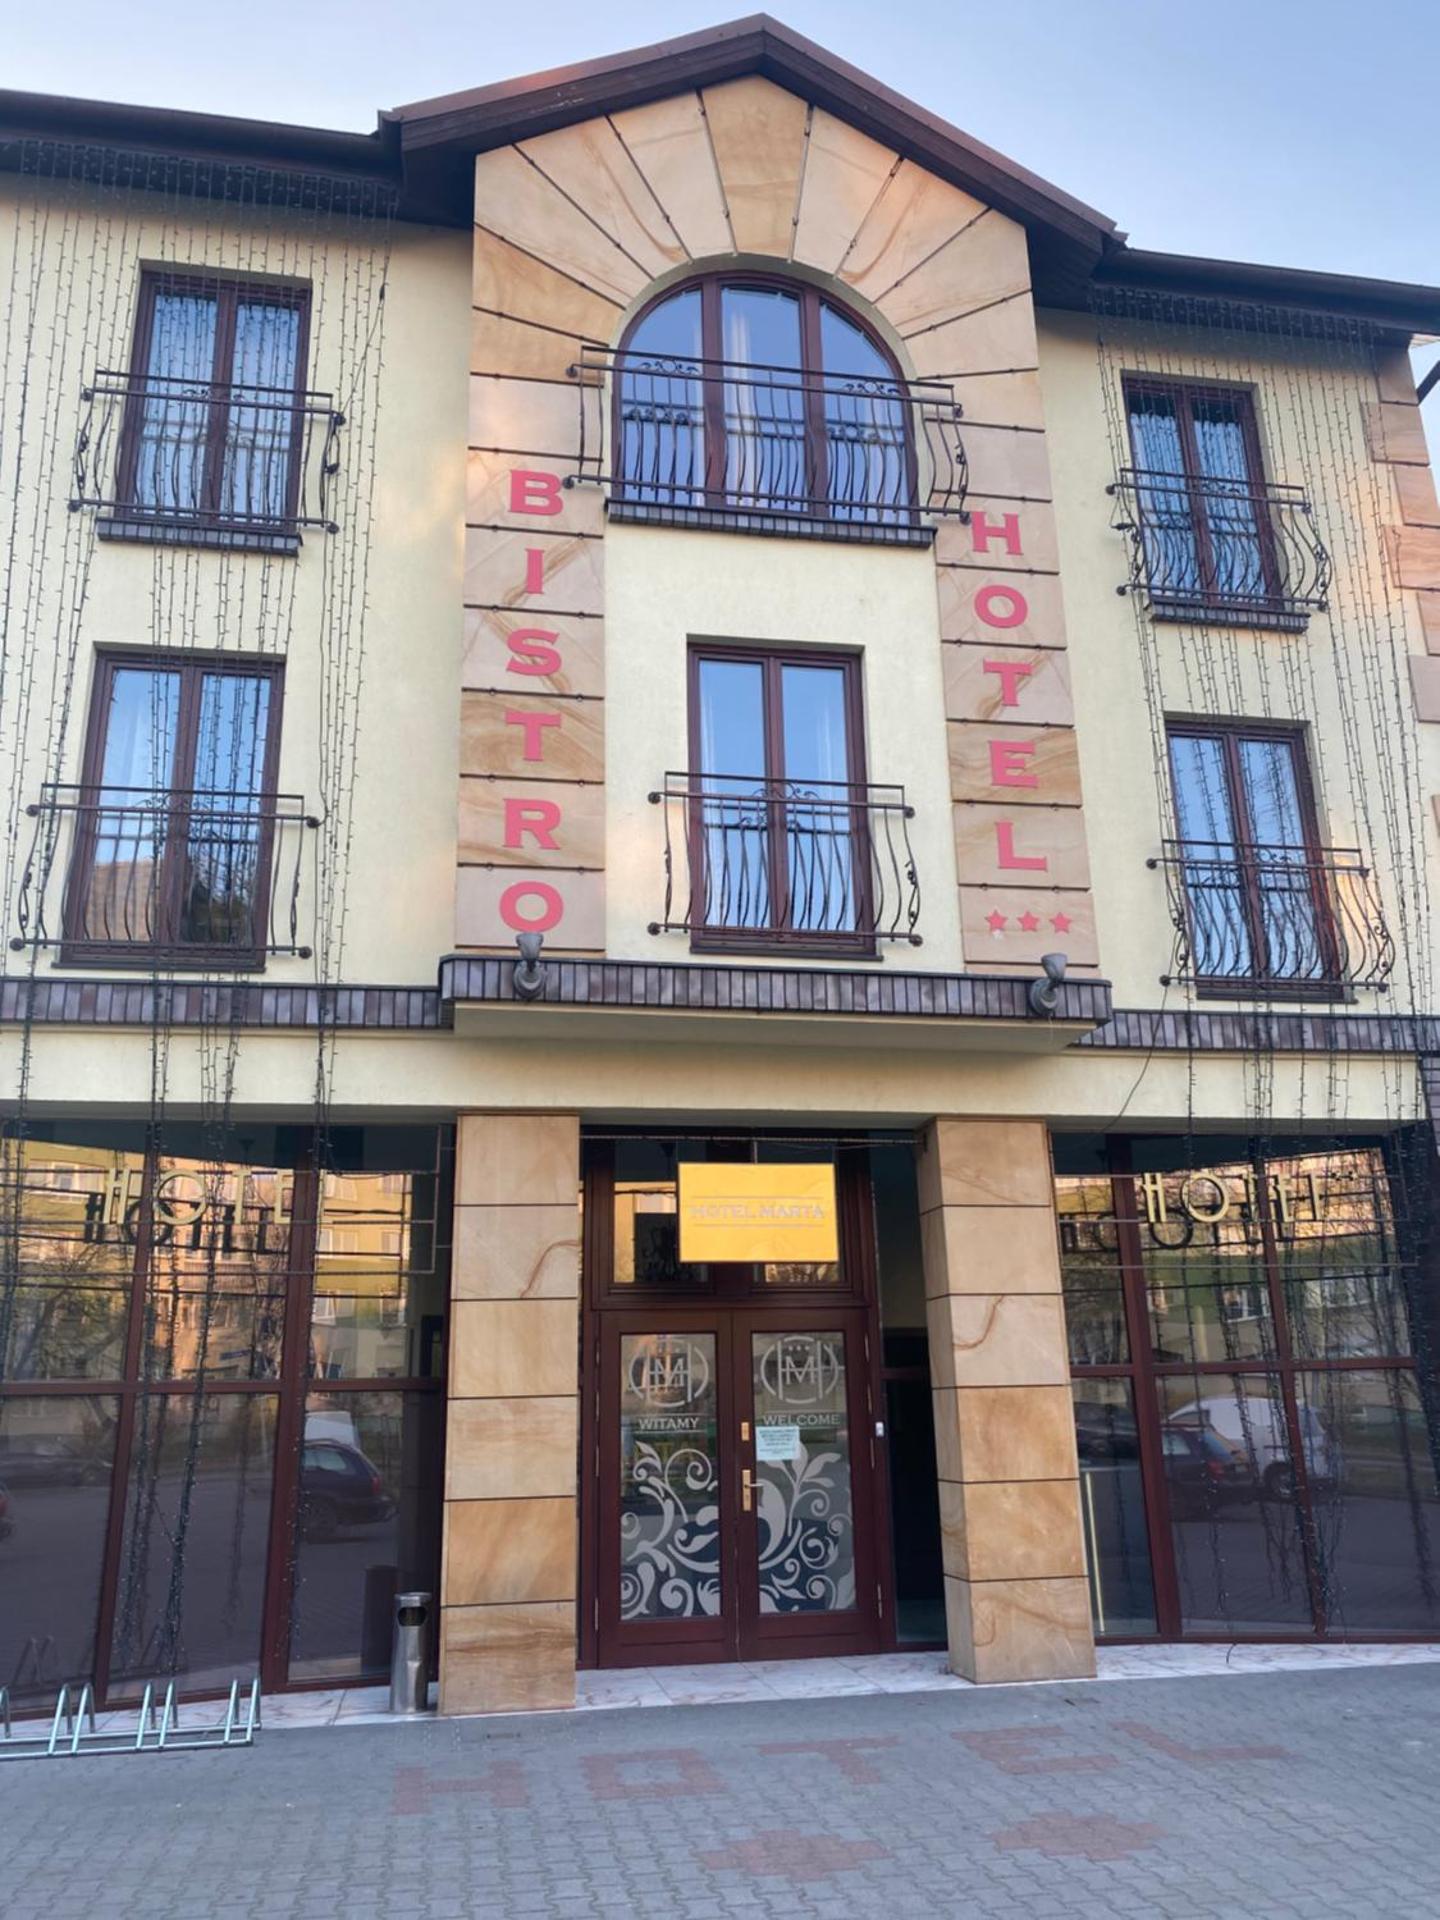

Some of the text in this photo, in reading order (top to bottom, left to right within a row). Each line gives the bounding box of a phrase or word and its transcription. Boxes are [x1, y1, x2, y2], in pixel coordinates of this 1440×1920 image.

[971, 511, 1047, 870] HOTEL
[499, 469, 564, 933] BISTRO
[690, 1205, 756, 1219] HOTEL
[639, 1416, 700, 1431] WITAMY
[763, 1414, 841, 1426] WELCOME
